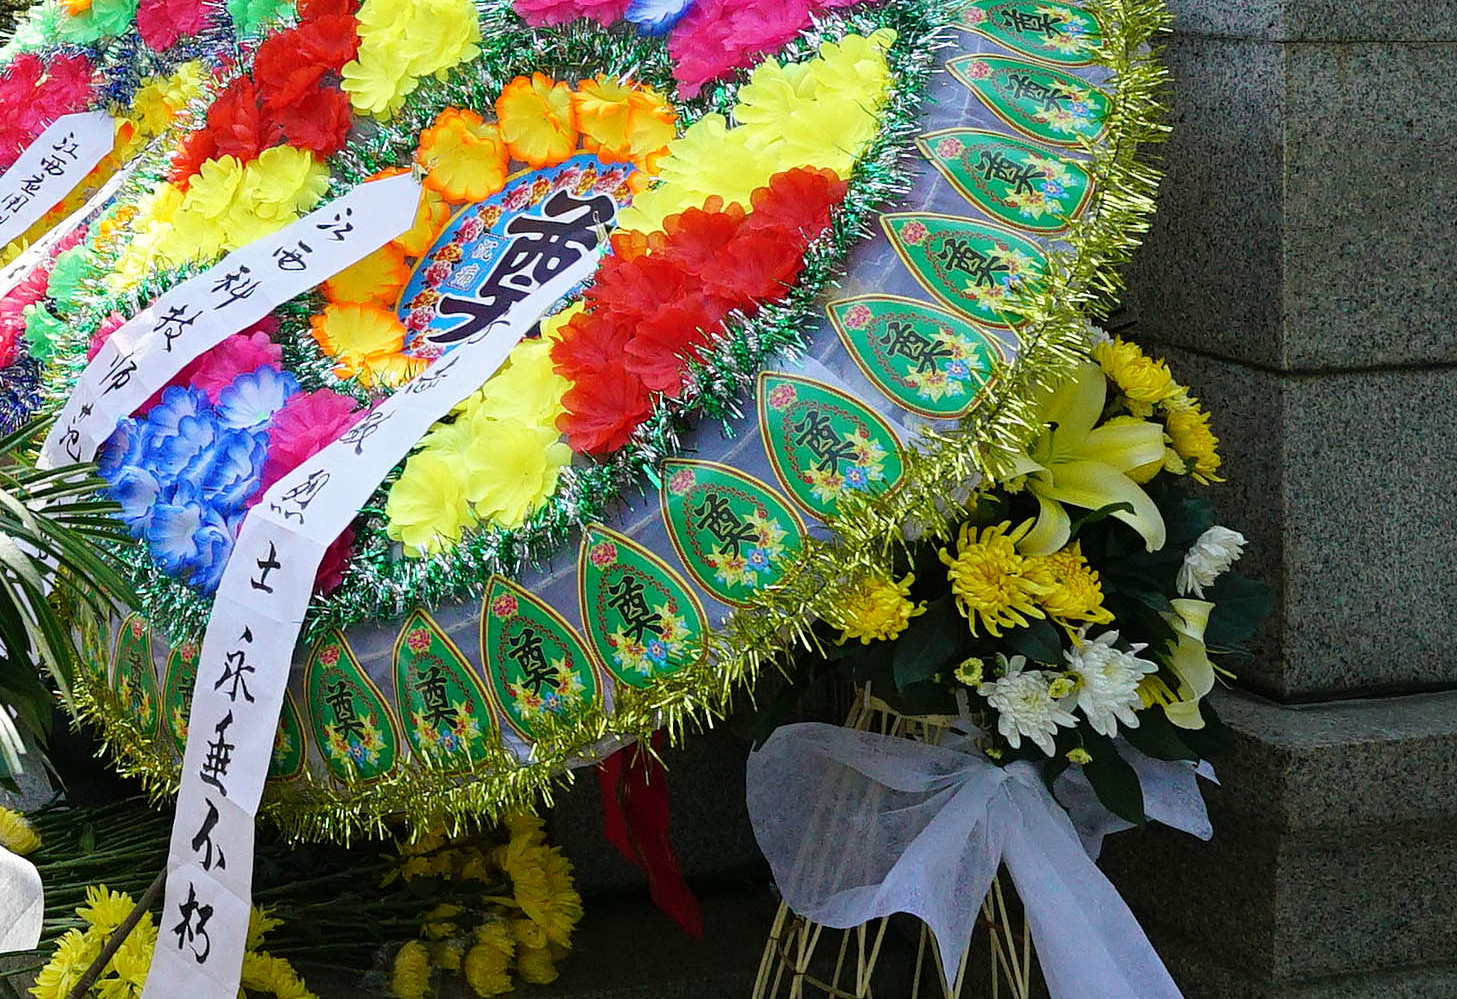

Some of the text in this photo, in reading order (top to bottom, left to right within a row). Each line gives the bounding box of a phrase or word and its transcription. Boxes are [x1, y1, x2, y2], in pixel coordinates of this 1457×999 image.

[1003, 9, 1062, 38] 奠
[1007, 73, 1072, 113] 奠
[975, 151, 1045, 195] 奠
[424, 188, 617, 344] 奠
[937, 237, 1011, 289] 奠
[881, 321, 953, 375] 奠
[795, 409, 861, 477] 奠
[695, 493, 761, 560] 奠
[169, 305, 510, 965] 志敏烈士永垂不朽
[608, 575, 665, 645] 奠
[509, 627, 561, 696] 奠
[326, 680, 366, 742] 奠
[415, 666, 459, 730] 奠
